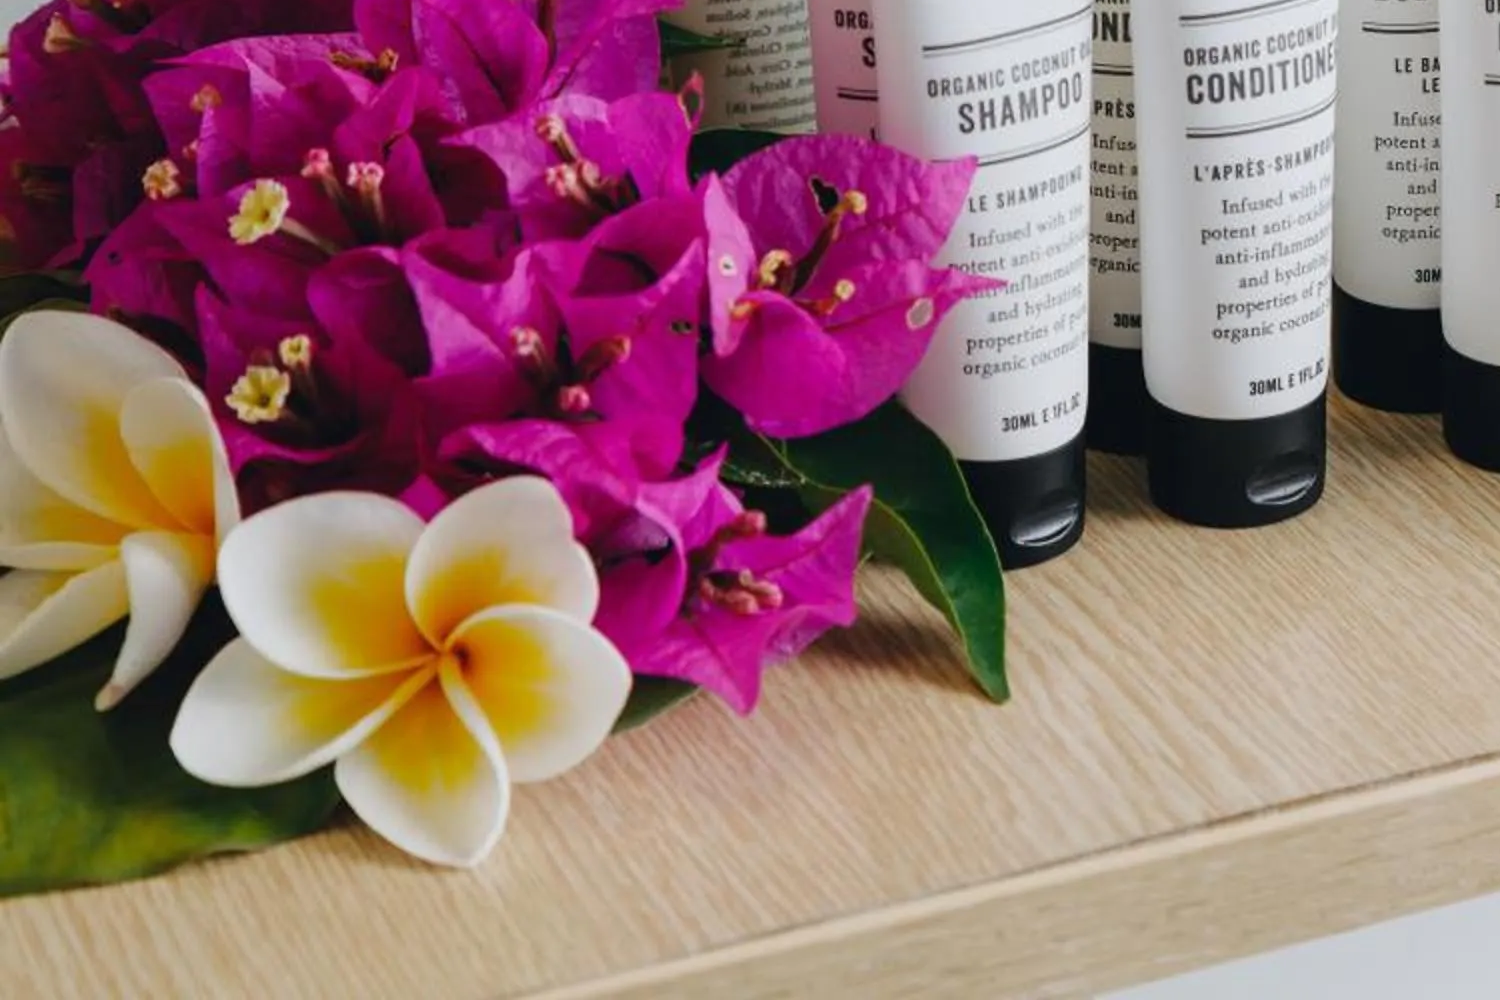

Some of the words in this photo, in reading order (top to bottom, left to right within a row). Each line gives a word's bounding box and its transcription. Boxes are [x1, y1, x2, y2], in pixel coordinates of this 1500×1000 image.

[1183, 39, 1260, 67] ORGANIC
[1267, 18, 1328, 55] COCONUT
[927, 70, 1004, 98] ORGANIC
[1011, 46, 1076, 83] COCONUT
[1395, 57, 1413, 73] LE
[1422, 77, 1441, 93] LE
[959, 72, 1082, 134] SHAMPOO
[1375, 135, 1427, 151] potent
[1407, 180, 1437, 195] and
[969, 195, 987, 213] LE
[1222, 190, 1283, 215] Infused
[1105, 209, 1135, 225] and
[970, 221, 1031, 248] Infused
[1201, 224, 1256, 246] potent
[1239, 269, 1269, 289] and
[988, 303, 1018, 323] and
[1217, 293, 1298, 321] properties
[967, 325, 1048, 355] properties
[1212, 321, 1275, 345] organic
[963, 355, 1026, 379] organic
[1250, 377, 1284, 396] 30ML
[1002, 412, 1039, 432] 30ML
